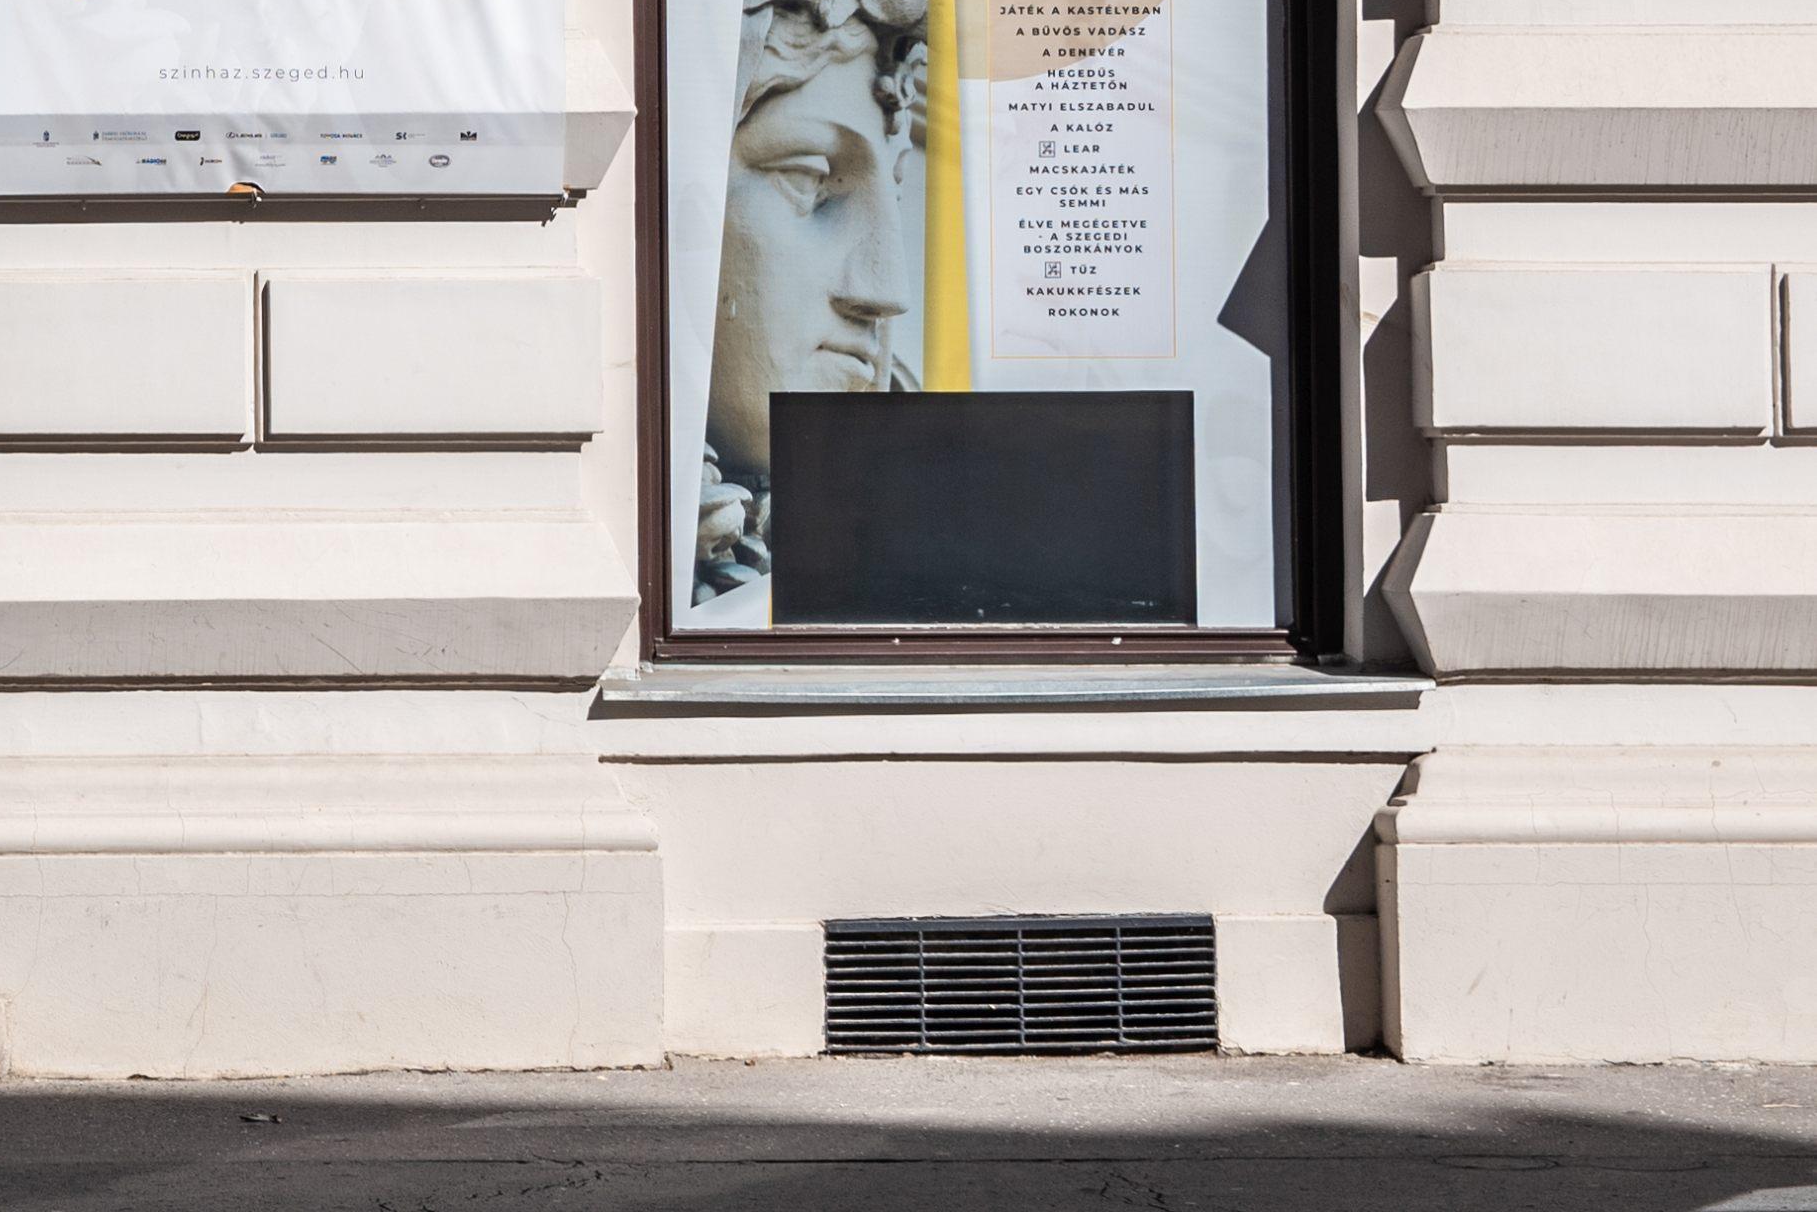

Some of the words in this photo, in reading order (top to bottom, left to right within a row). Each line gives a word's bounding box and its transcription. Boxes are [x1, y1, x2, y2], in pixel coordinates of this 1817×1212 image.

[1000, 5, 1044, 14] JÁTÉK
[1068, 6, 1161, 14] KASTÉLYBAN
[1033, 26, 1081, 35] BŰVÖS
[1088, 26, 1145, 35] VADÁSZ
[1059, 47, 1125, 56] DENEVÉR
[159, 65, 364, 81] szinhaz.szeged.hu
[1048, 68, 1115, 77] HEGEDŰS
[1051, 80, 1128, 90] HÁZTETŐN
[1009, 102, 1052, 111] MATYI
[1060, 102, 1155, 111] ELSZABADUL
[1067, 122, 1113, 131] KALÓZ
[1030, 164, 1135, 174] MACSKAJÁTÉK
[1016, 187, 1042, 195] EGY
[1051, 185, 1088, 195] CSÓK
[1096, 185, 1111, 195] ÉS
[1119, 185, 1149, 195] MÁS
[1019, 218, 1053, 228] ÉLVE
[1061, 219, 1147, 228] MEGÉGETVE
[1024, 244, 1143, 253] BOSZORKÁNYOK
[1027, 286, 1141, 295] KAKUKKFÉSZEK
